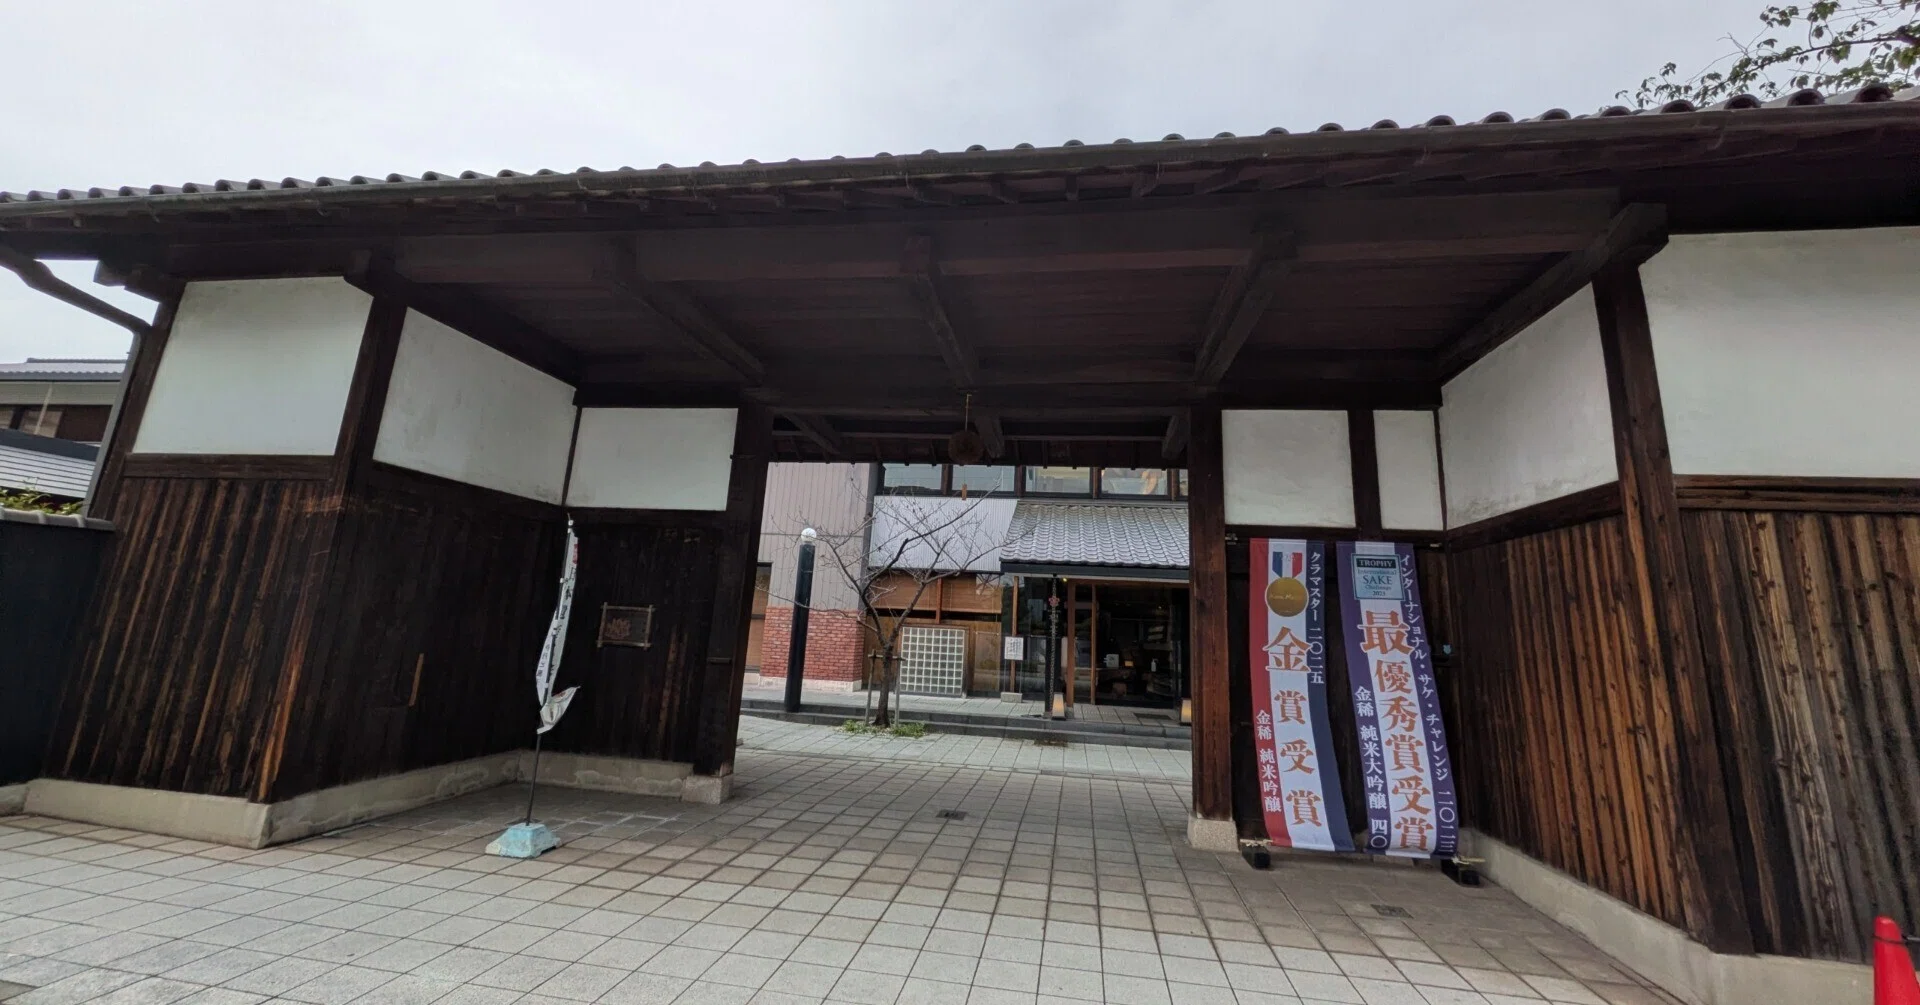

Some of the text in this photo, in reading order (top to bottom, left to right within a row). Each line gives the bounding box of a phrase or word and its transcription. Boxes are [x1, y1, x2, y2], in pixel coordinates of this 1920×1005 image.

[1309, 551, 1322, 622] クラマスター
[1362, 574, 1393, 585] SAKE
[1354, 685, 1374, 717] 金稀
[1400, 554, 1448, 781] インターナショナル・サケ・チャレンジ
[1255, 709, 1282, 813] 金稀 純米吟醸
[1262, 626, 1322, 827] 金賞受賞
[1357, 610, 1435, 851] 最優秀賞受賞
[1359, 724, 1388, 810] 純米大吟醸
